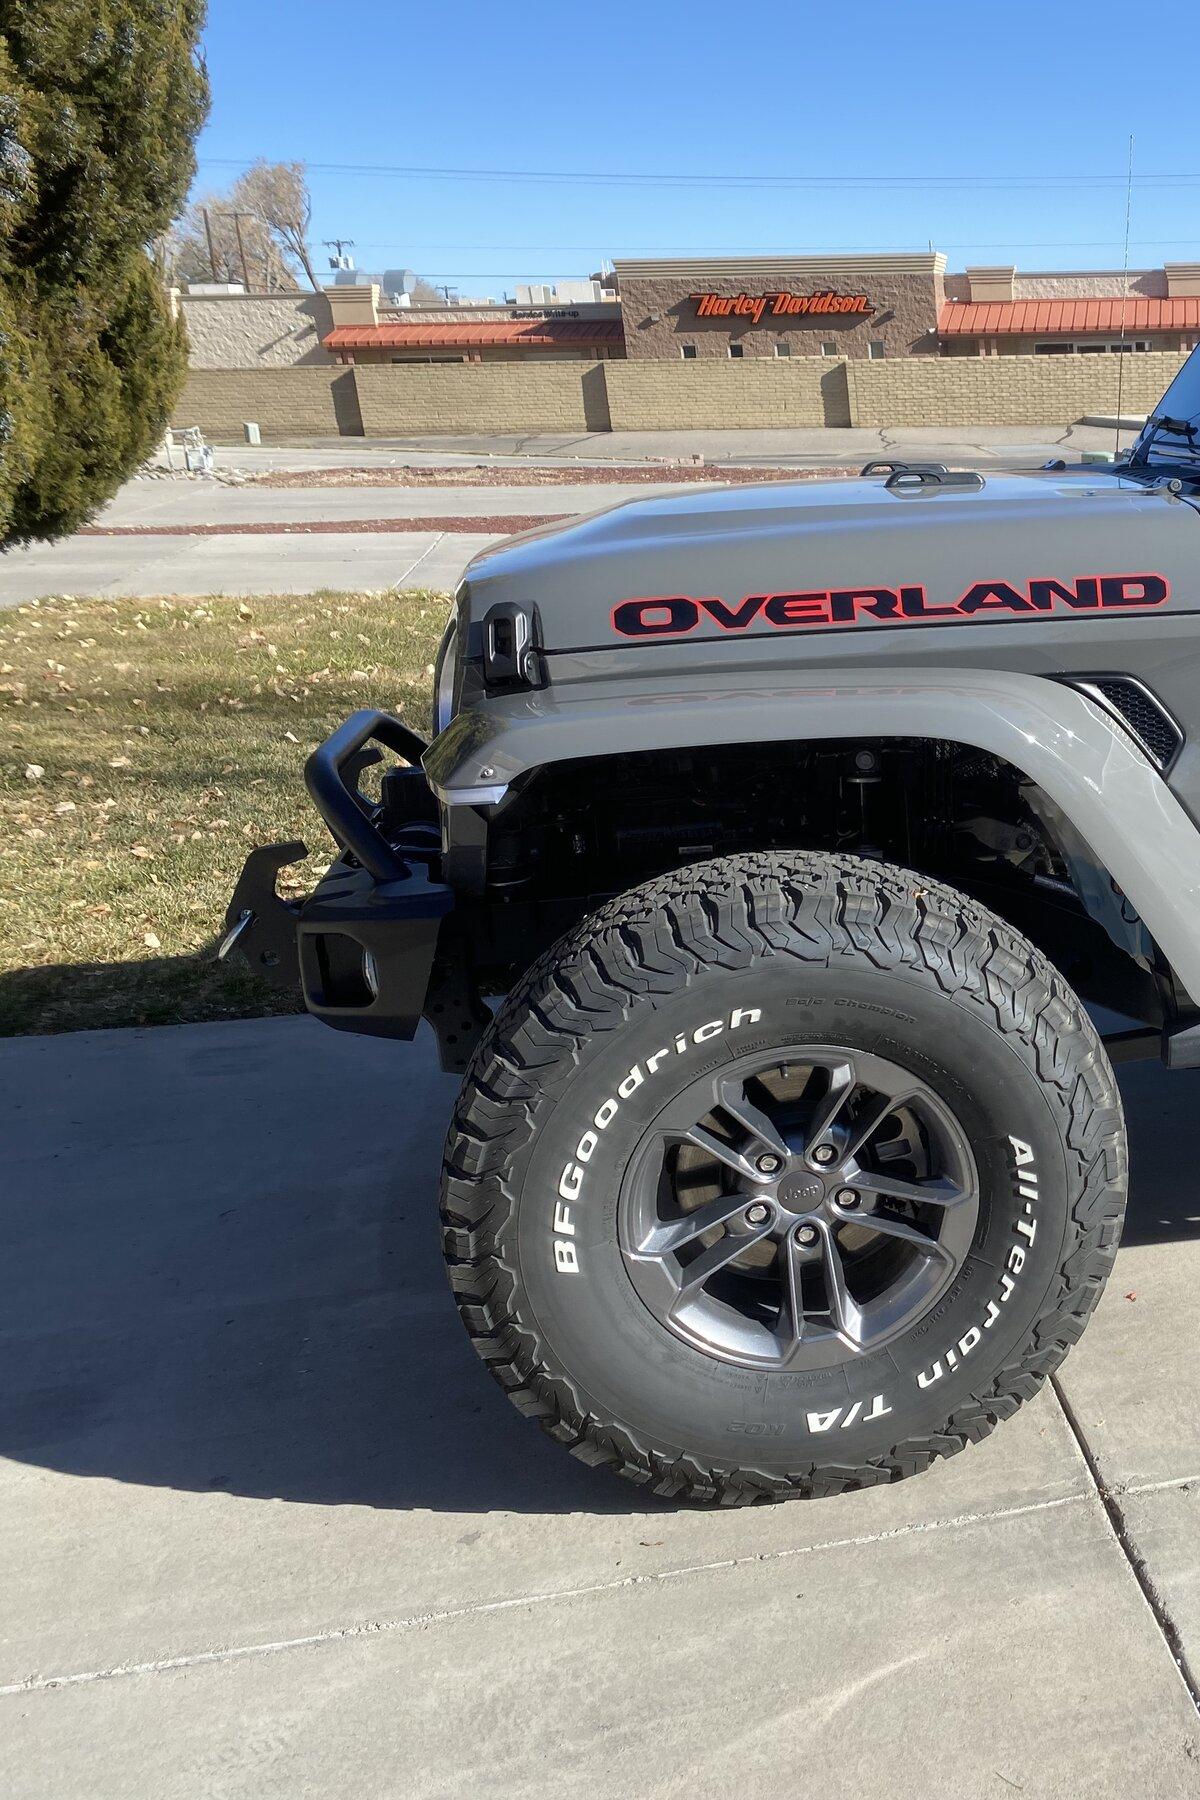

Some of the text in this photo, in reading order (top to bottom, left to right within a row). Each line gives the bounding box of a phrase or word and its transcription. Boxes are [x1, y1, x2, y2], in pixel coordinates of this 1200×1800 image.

[511, 309, 579, 319] Service Write-up
[690, 291, 876, 324] Harley-Davidson
[611, 571, 1171, 637] OVERLAND
[552, 1006, 762, 1275] BFGoodrich
[917, 1134, 1039, 1389] All-Terrain
[806, 1394, 892, 1434] T/A
